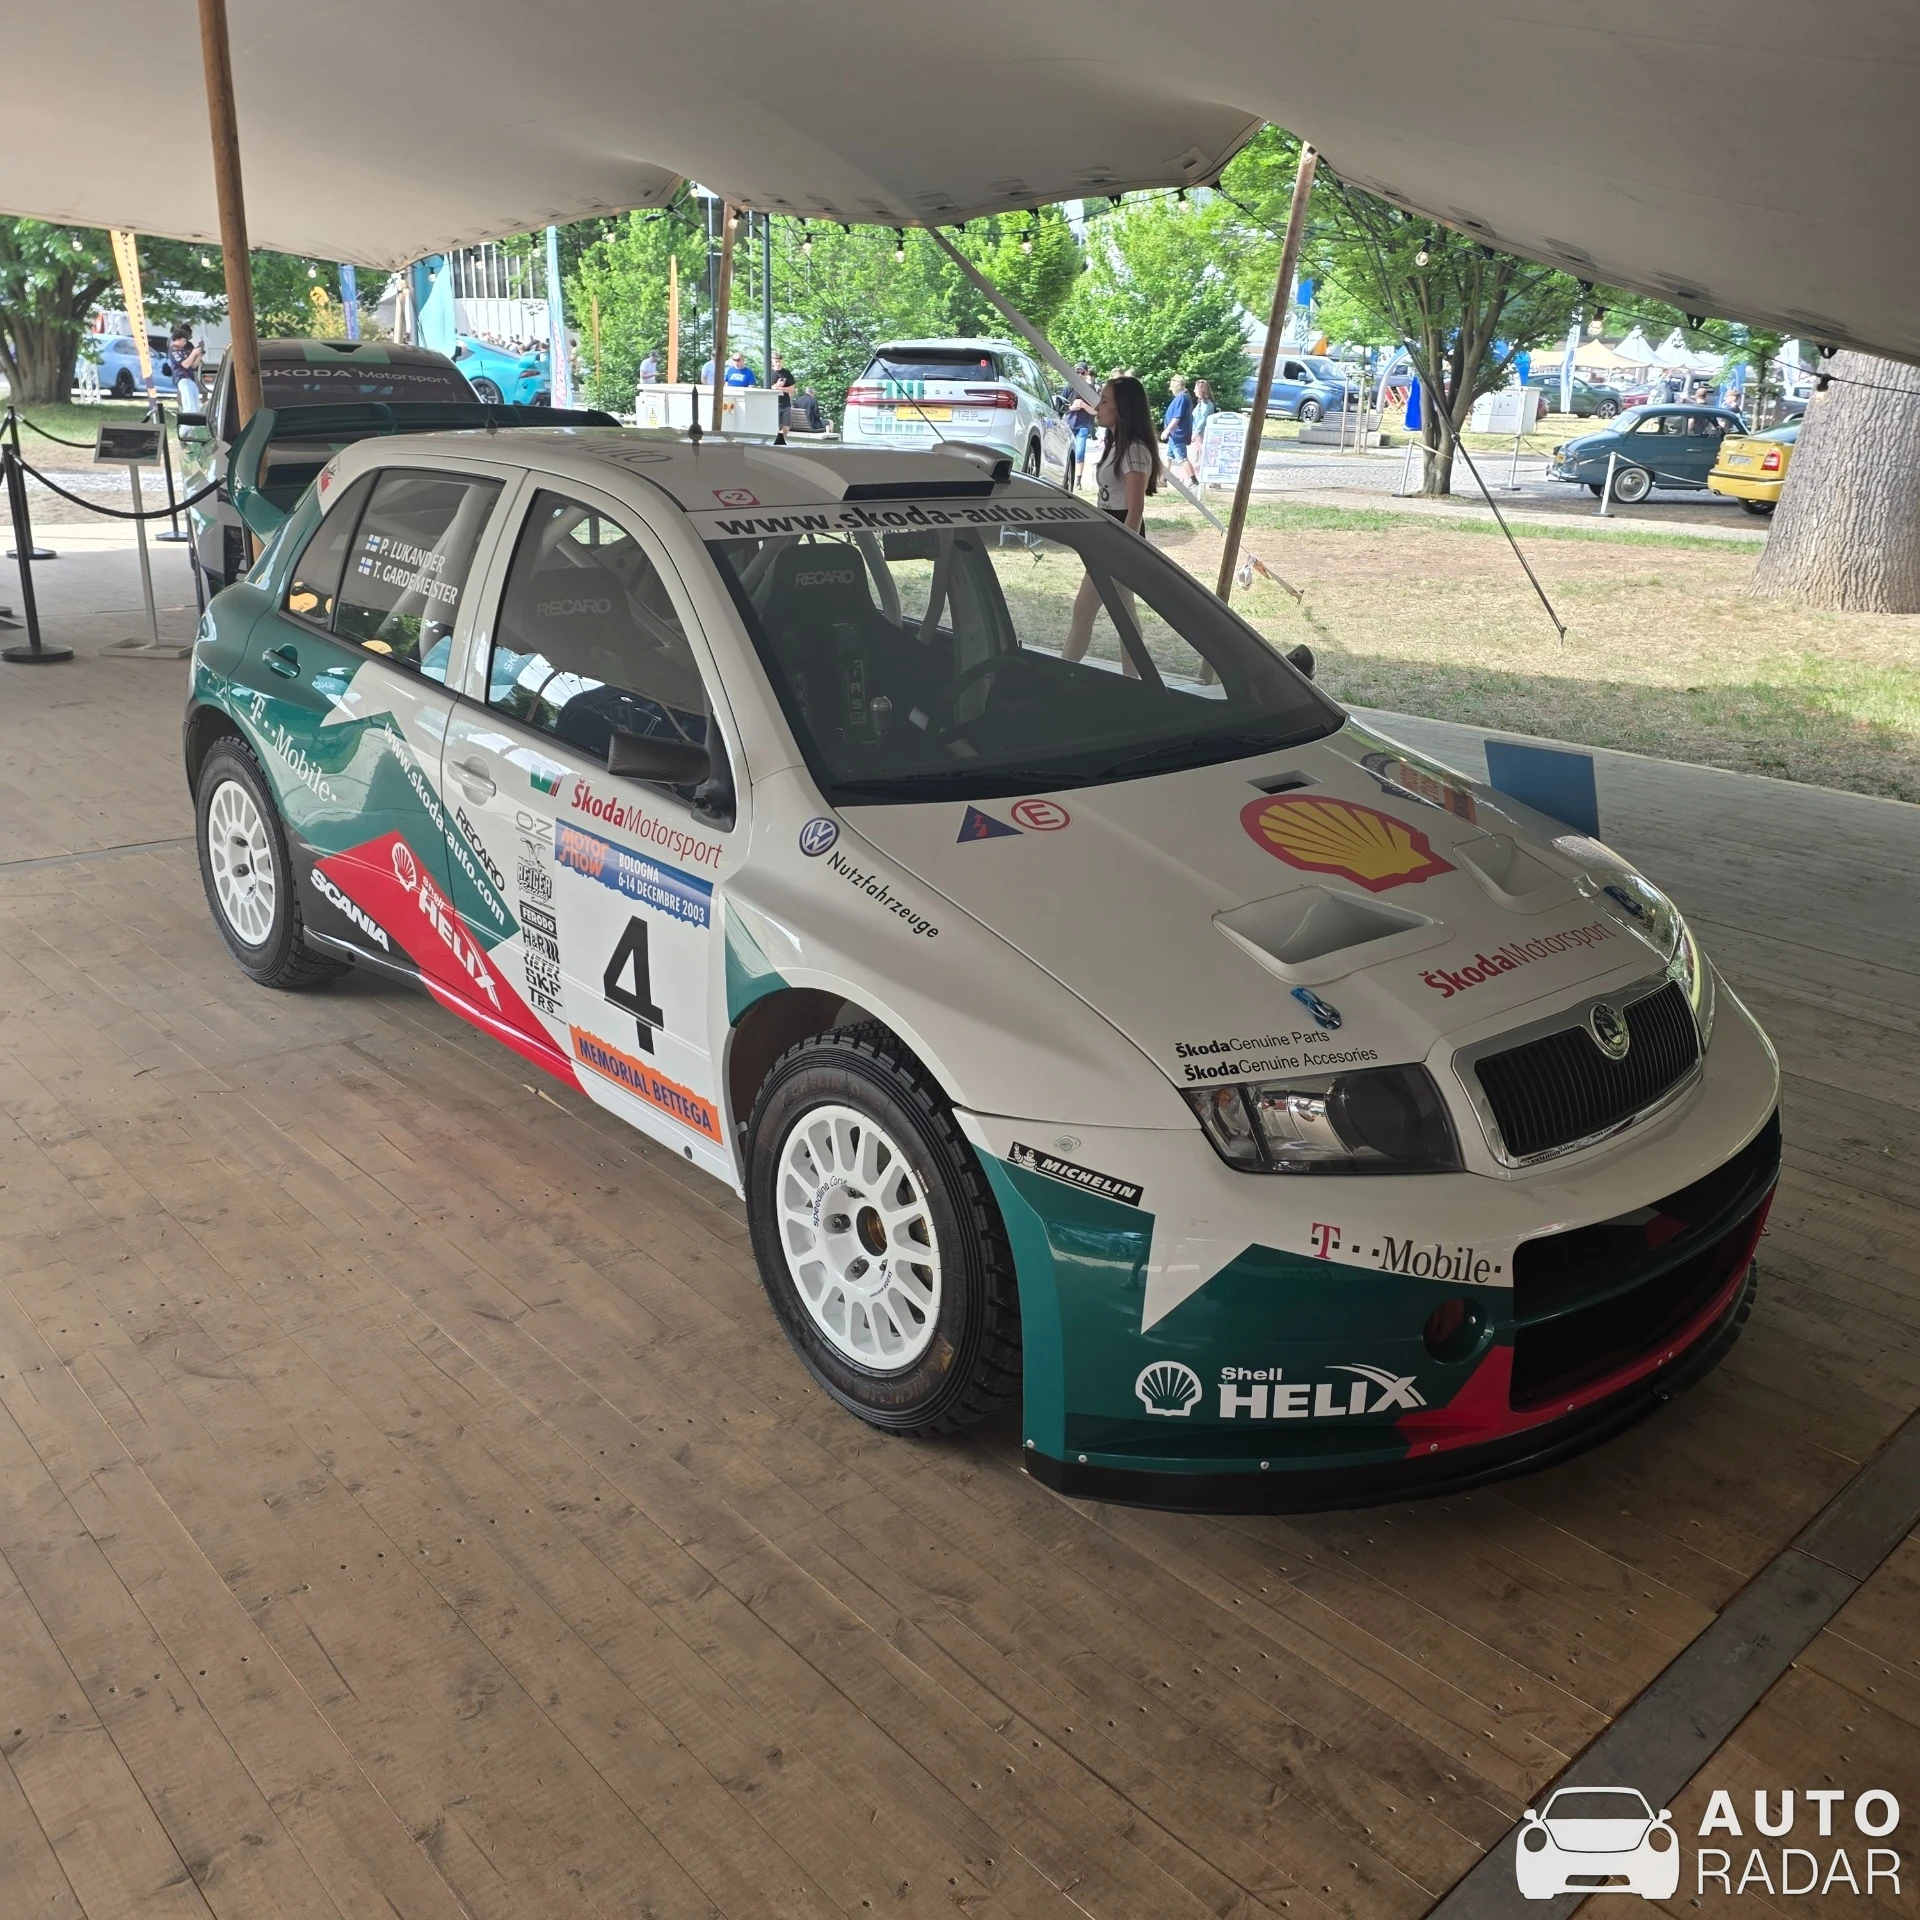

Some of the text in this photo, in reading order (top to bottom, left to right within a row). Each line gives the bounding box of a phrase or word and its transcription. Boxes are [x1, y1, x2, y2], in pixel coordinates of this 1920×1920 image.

[357, 370, 452, 386] Motorsport
[714, 504, 1090, 536] www.skoda-auto.com
[379, 537, 446, 574] P. LUKANDER
[373, 560, 459, 605] T. GARDEMEISTER
[795, 569, 855, 587] RECARO
[536, 597, 612, 618] RECARO
[384, 721, 505, 926] www.skoda-auto.com
[1019, 803, 1061, 826] E
[456, 806, 505, 892] RECARO
[618, 852, 660, 883] BOLOGNA
[310, 867, 390, 953] SCANIA
[422, 875, 445, 911] Shell
[618, 871, 705, 924] 6-14 DECEMBRE 2003
[827, 850, 940, 938] Nutzfahrzeuge
[522, 906, 556, 931] FERODO
[418, 885, 502, 1013] HELIX
[522, 925, 547, 955] H&R
[525, 966, 562, 997] SKF
[528, 985, 562, 1013] TRS
[603, 914, 665, 1056] 4
[1291, 1030, 1330, 1045] Parts
[1302, 1048, 1379, 1068] Accesories
[578, 1036, 713, 1133] MEMORIAL BETTEGA
[1040, 1158, 1137, 1199] MICHELIN
[813, 1175, 848, 1228] speedline Corse
[1217, 1362, 1428, 1419] HELIX
[1220, 1366, 1283, 1381] Shell
